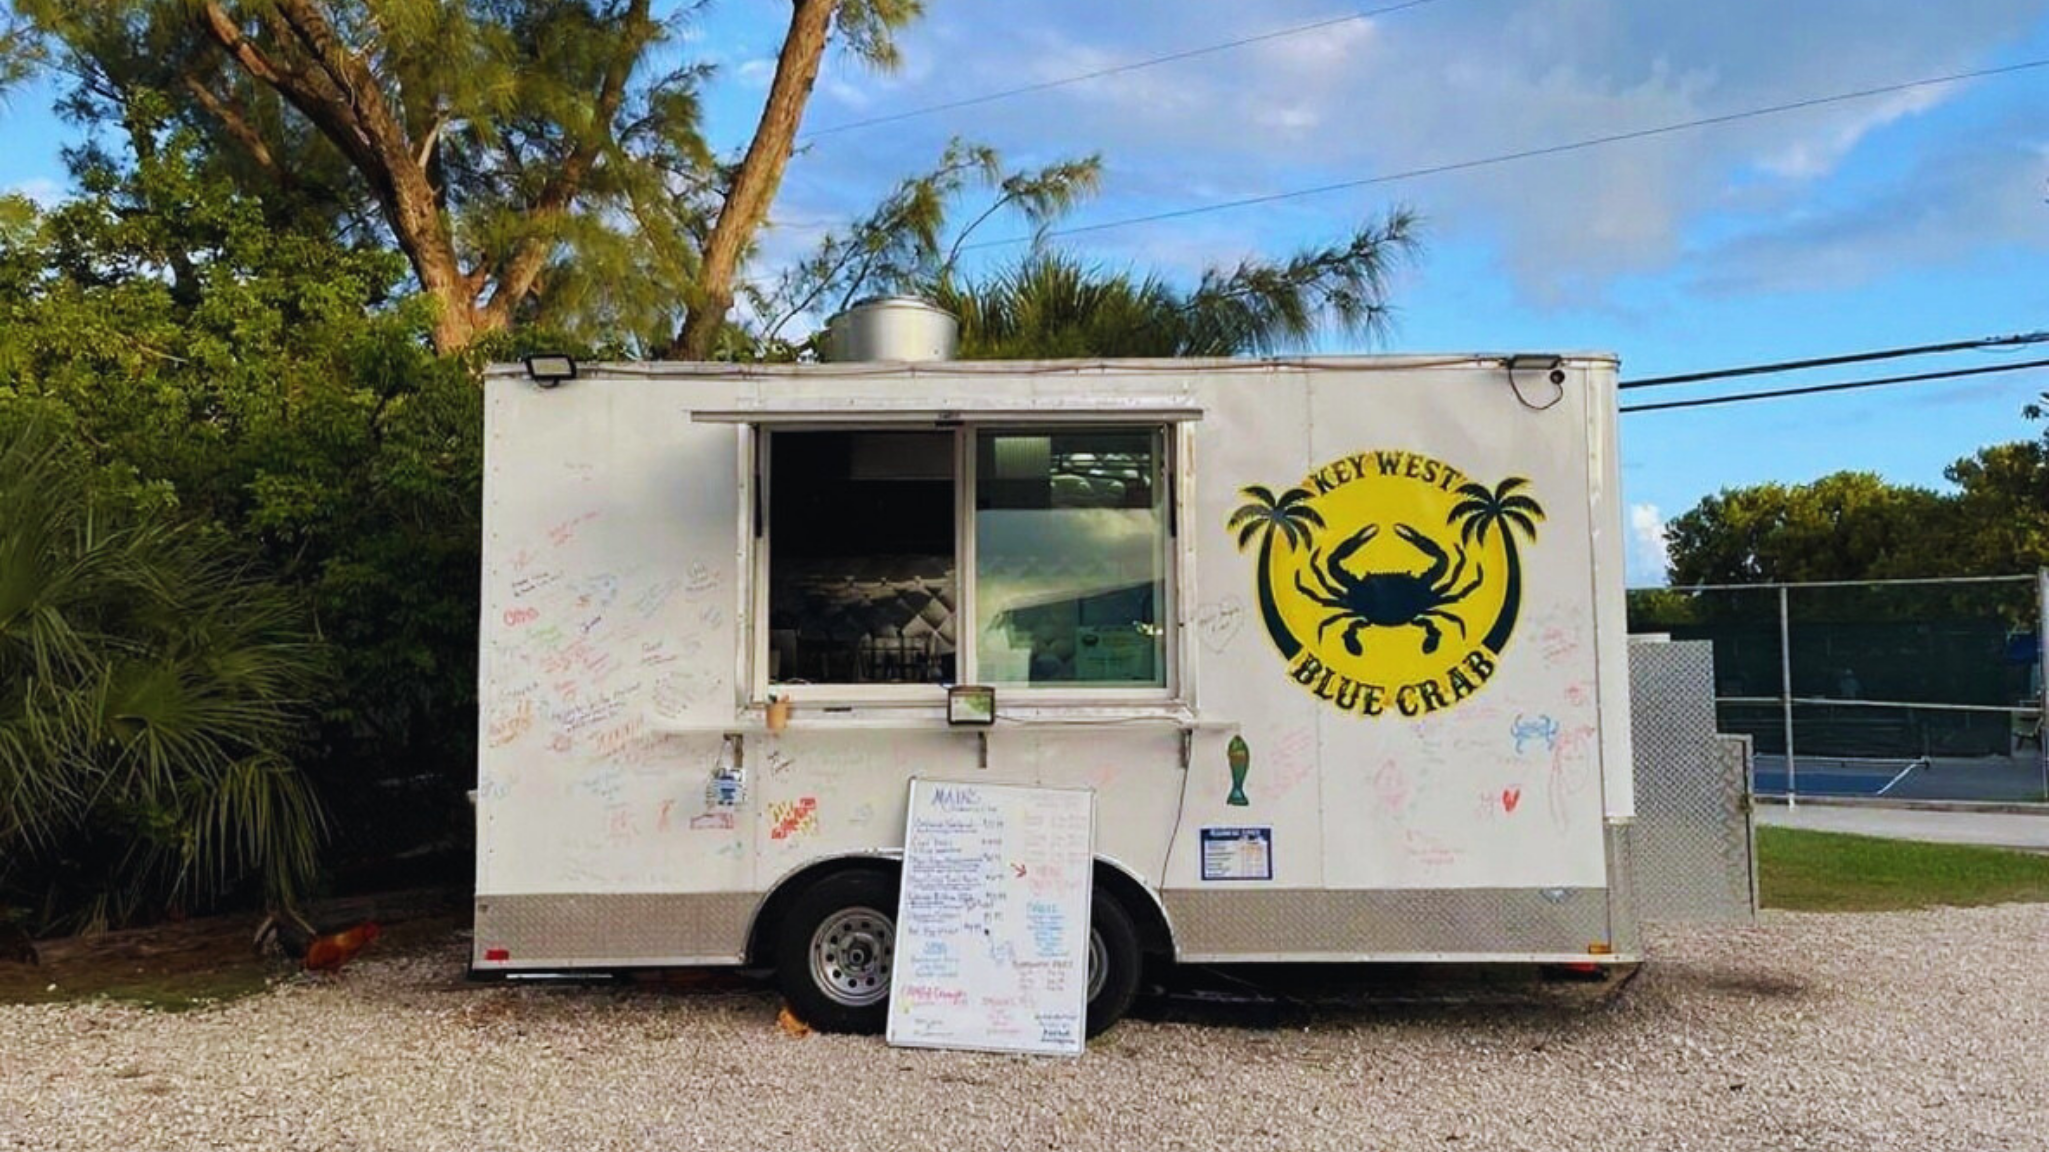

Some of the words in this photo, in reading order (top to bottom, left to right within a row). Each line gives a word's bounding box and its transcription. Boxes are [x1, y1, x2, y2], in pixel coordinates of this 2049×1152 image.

[1310, 454, 1366, 497] KEY
[1375, 451, 1462, 491] WEST
[1291, 653, 1385, 717] BLUE
[1396, 650, 1496, 718] CRAB
